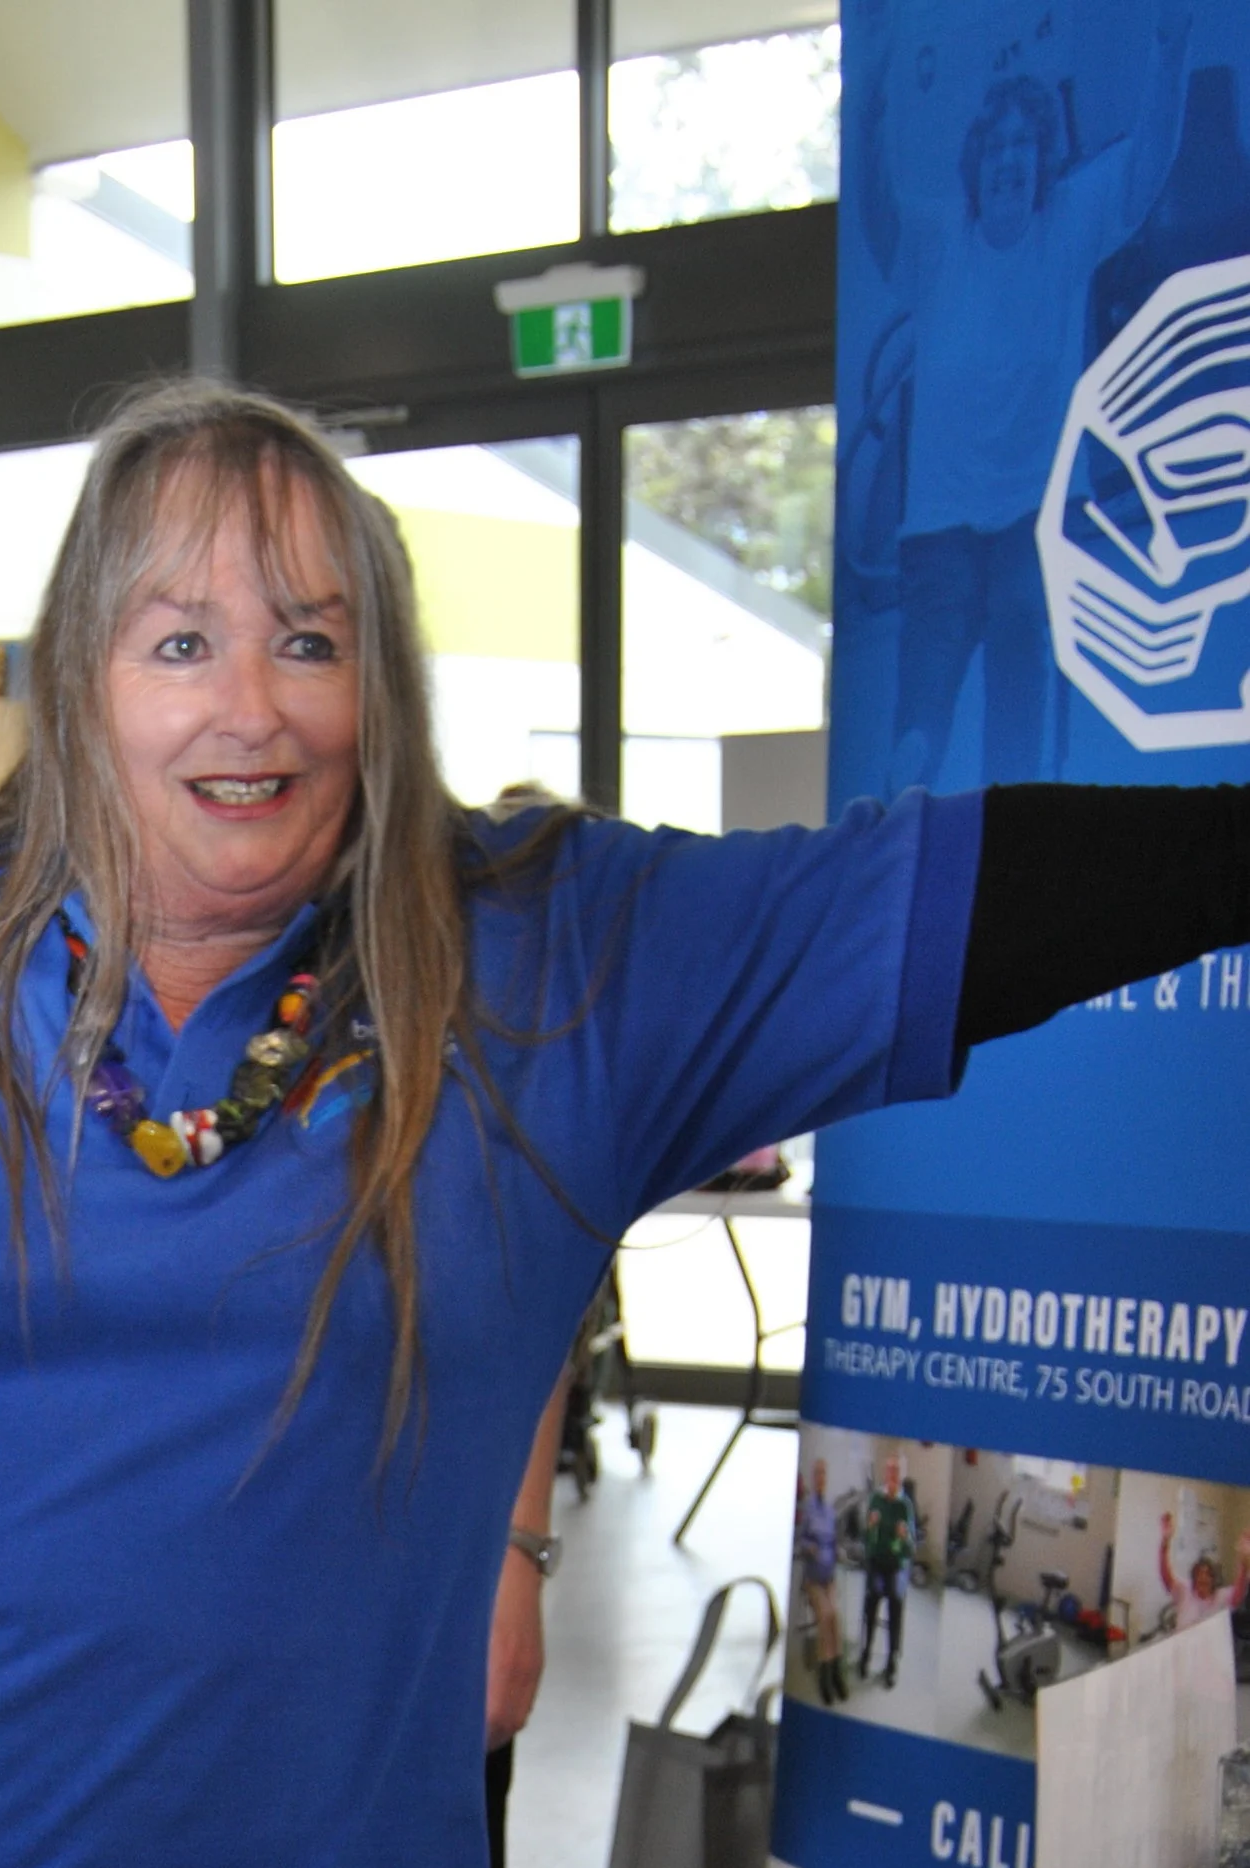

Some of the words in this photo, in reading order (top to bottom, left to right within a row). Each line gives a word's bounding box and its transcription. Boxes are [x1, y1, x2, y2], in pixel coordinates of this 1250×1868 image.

[1199, 953, 1250, 1010] TH
[841, 1273, 922, 1342] GYM,
[933, 1282, 1248, 1367] HYDROTHERAPY
[823, 1338, 922, 1382] THERAPY
[923, 1351, 1029, 1400] CENTRE,
[1036, 1365, 1069, 1400] 75
[1075, 1368, 1174, 1412] SOUTH
